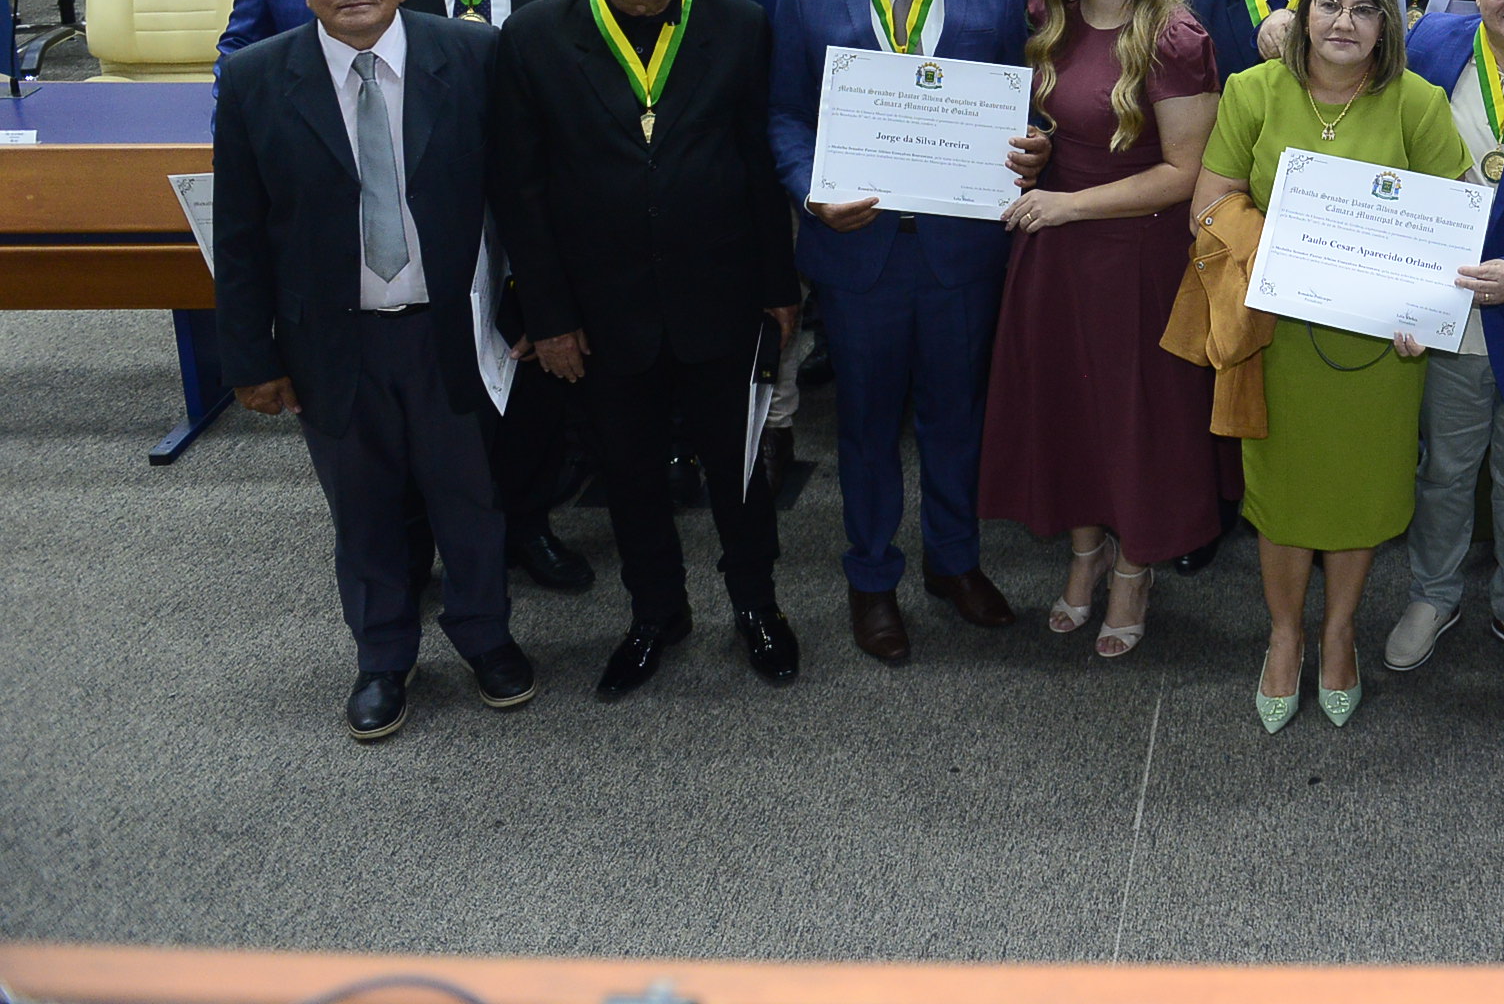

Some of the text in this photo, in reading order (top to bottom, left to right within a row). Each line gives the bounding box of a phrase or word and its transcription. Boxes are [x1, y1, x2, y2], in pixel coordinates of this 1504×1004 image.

[876, 132, 970, 149] Jorge da Silva Pereira
[1302, 234, 1443, 270] Paulo Cesar Aparecido Orlando
